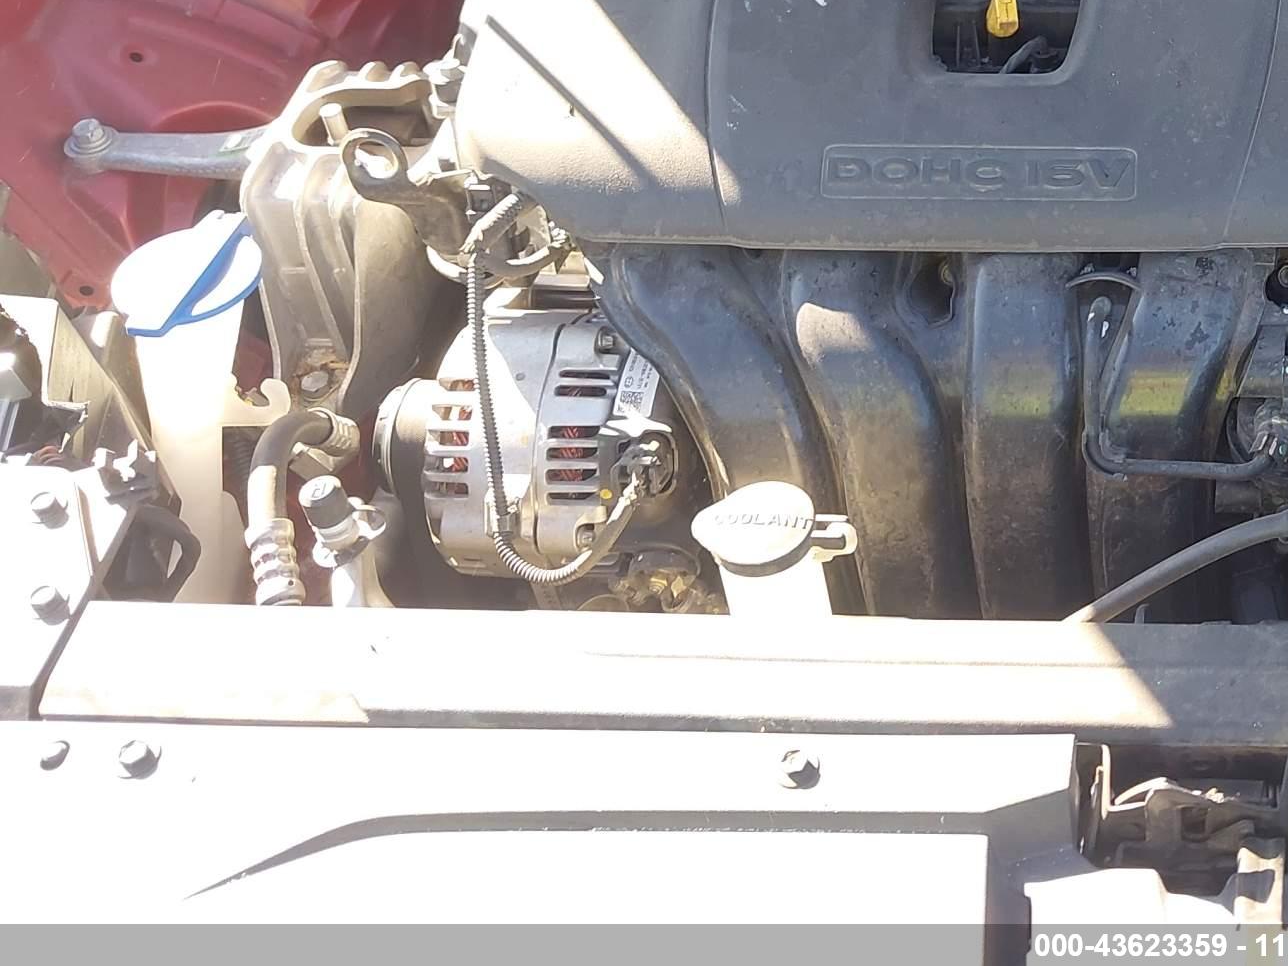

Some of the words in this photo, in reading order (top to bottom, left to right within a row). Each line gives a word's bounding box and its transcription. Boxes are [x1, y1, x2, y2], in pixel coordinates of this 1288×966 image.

[825, 155, 1008, 190] DOHC
[1024, 157, 1131, 189] 16V
[714, 513, 813, 530] COOLANT
